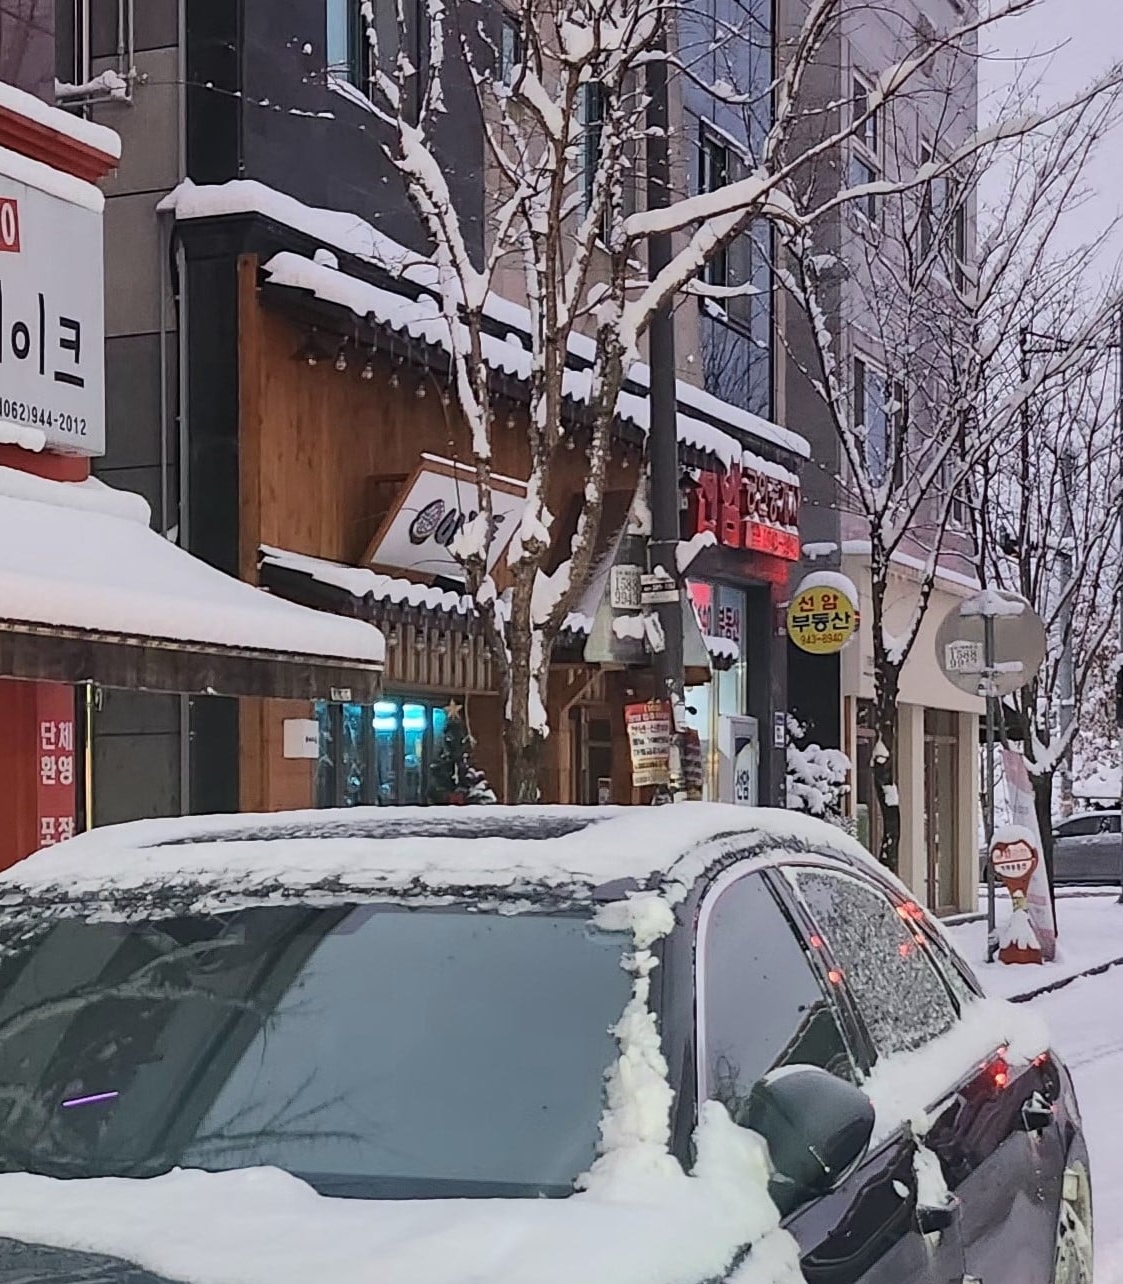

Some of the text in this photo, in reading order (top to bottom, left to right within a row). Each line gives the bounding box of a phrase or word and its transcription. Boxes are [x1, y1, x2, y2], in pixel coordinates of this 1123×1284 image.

[792, 611, 851, 632] 부동산
[40, 721, 73, 750] 단체
[40, 755, 73, 785] 환영
